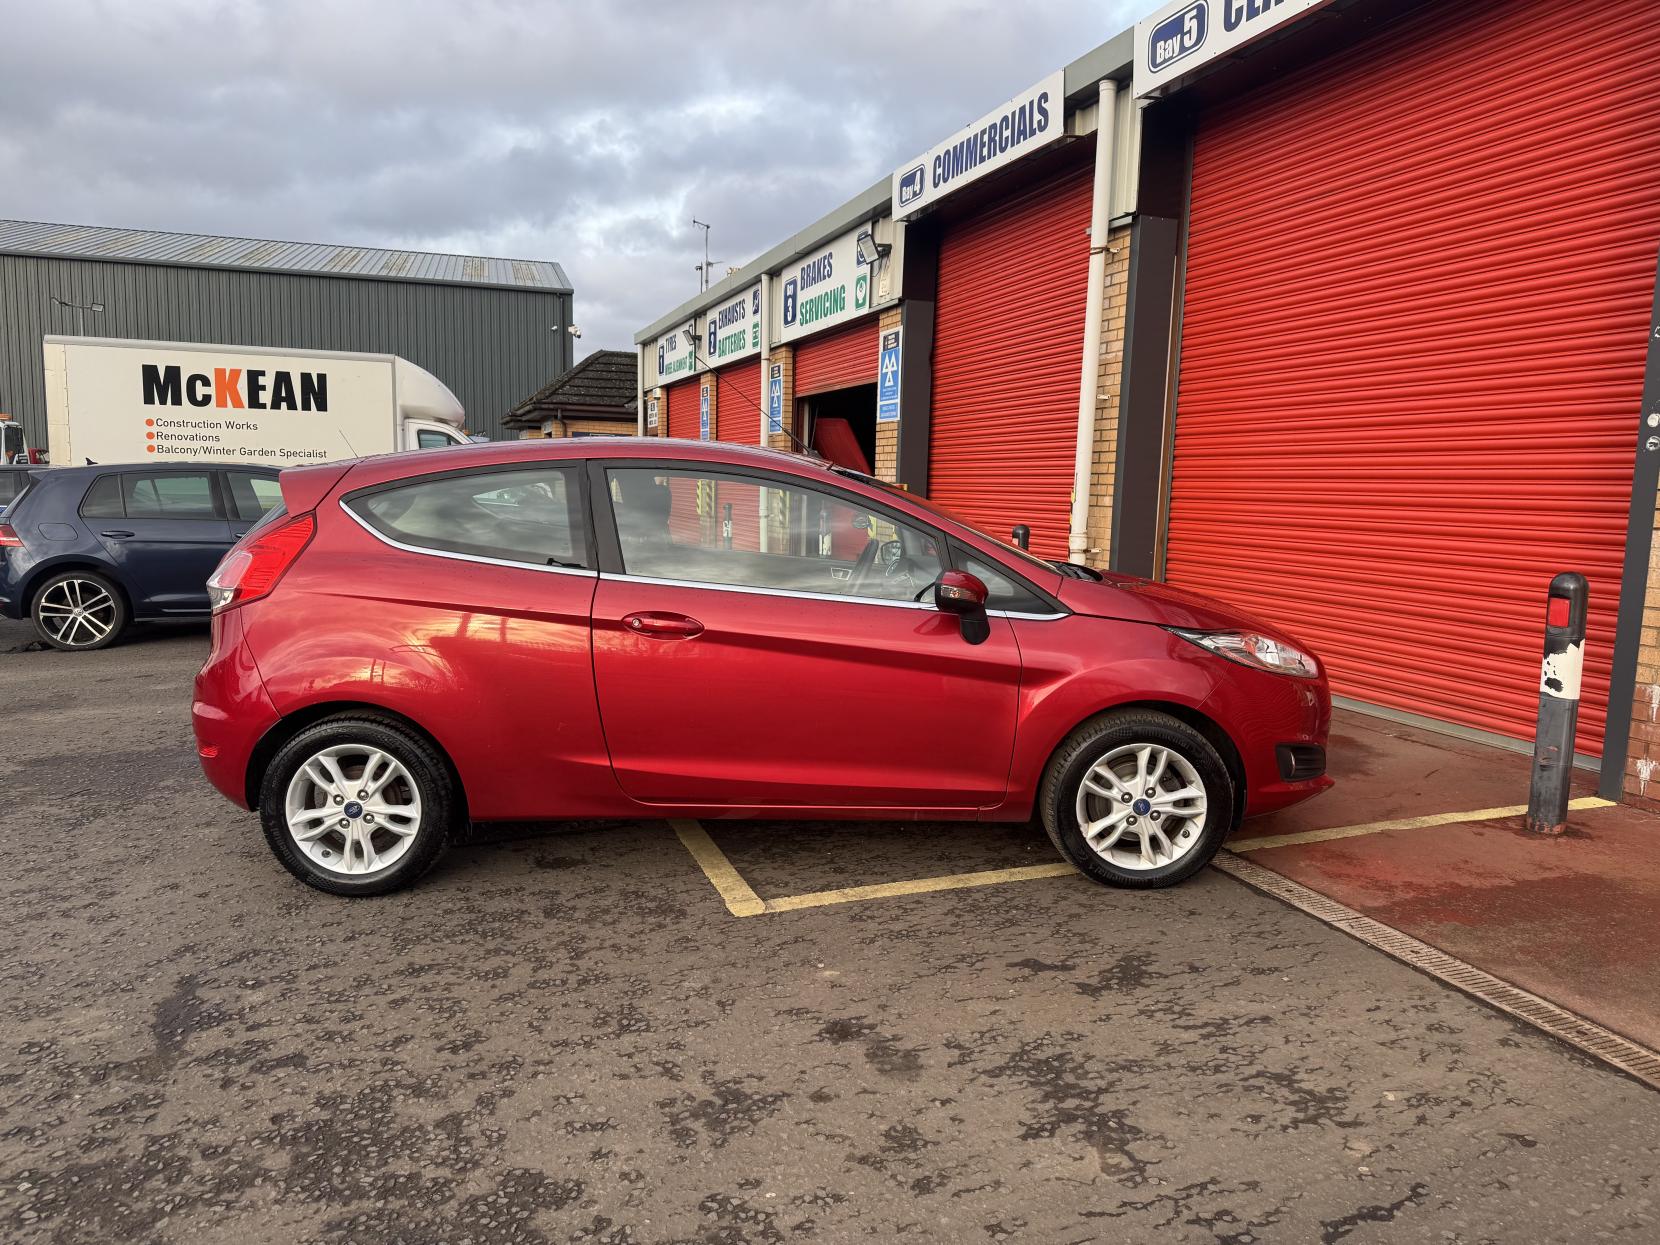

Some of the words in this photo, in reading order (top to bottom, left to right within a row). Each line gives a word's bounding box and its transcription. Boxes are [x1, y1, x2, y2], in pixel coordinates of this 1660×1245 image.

[1156, 34, 1181, 64] Bay
[1183, 8, 1198, 48] 5
[932, 91, 1049, 189] COMMERCIALS
[902, 184, 913, 200] Bay
[914, 170, 921, 195] 4
[801, 252, 833, 291] BRAKES
[719, 298, 746, 330] EXHAUSTS
[787, 298, 793, 322] 3
[800, 284, 846, 327] SERVICING
[718, 328, 746, 358] BATTERIES
[142, 364, 328, 412] McKEAN
[156, 418, 222, 429] Construction
[225, 421, 258, 431] Works
[156, 431, 220, 442] Renovations
[157, 445, 236, 457] Balcony/Winter
[239, 447, 276, 457] Garden
[279, 448, 327, 460] Specialist
